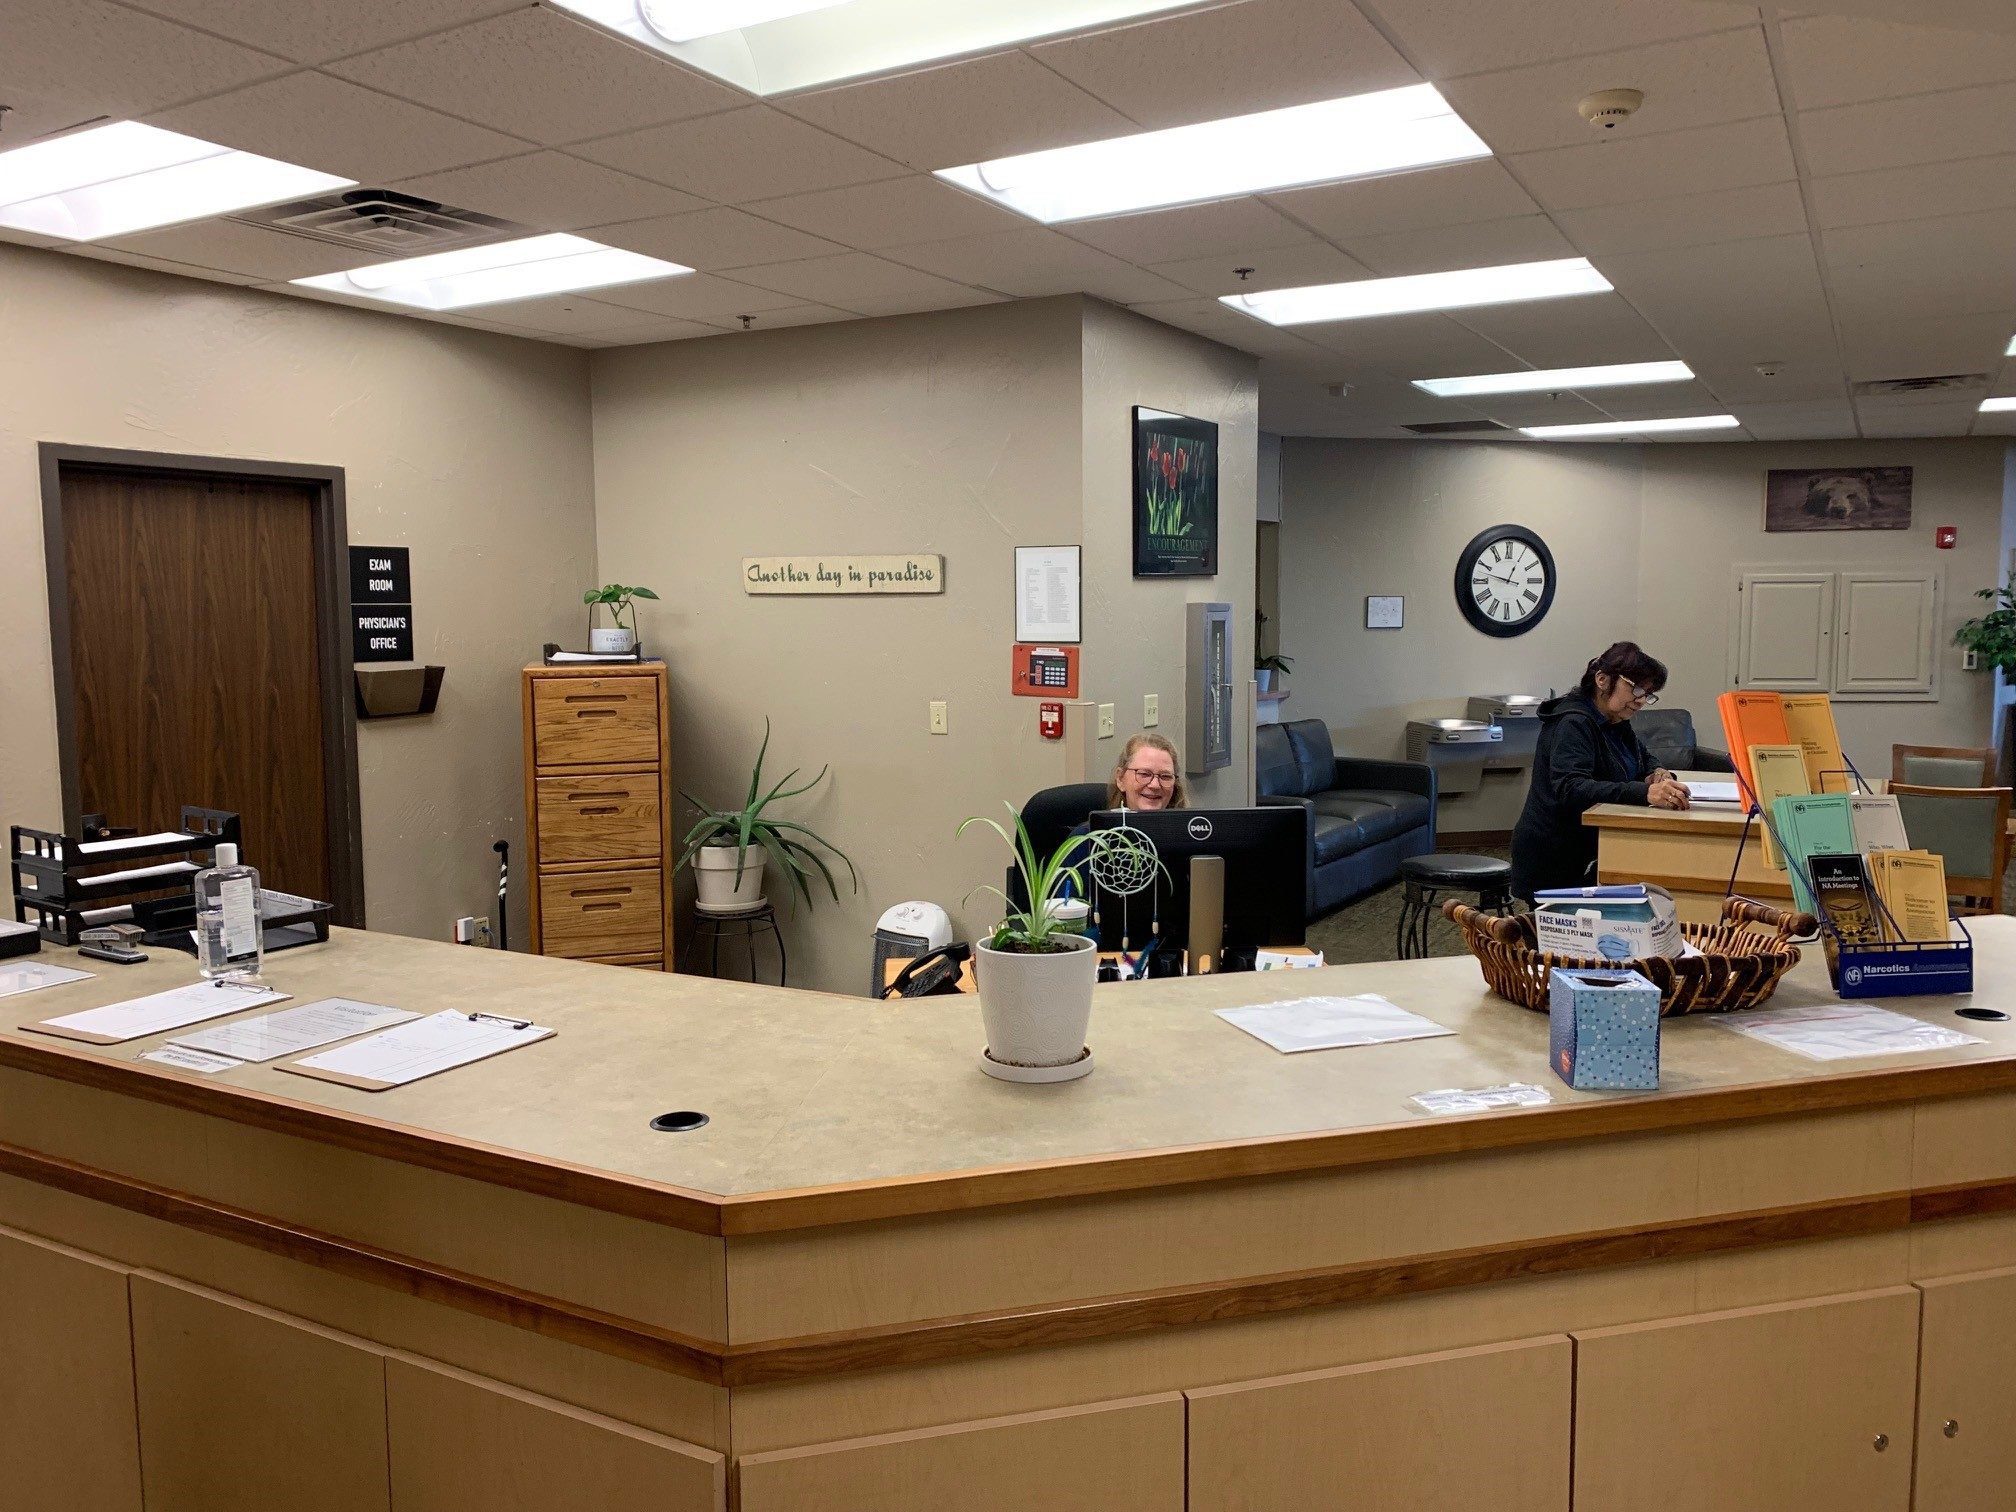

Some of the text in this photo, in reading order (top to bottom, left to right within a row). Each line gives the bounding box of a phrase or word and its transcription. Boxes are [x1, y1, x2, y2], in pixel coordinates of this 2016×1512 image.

[369, 559, 391, 571] EXAM
[747, 562, 934, 588] Another day in paradise
[369, 579, 393, 591] ROOM
[358, 617, 406, 629] PHYSICIAN'S
[370, 638, 398, 650] OFFICE
[1818, 874, 1852, 882] Introduction
[1833, 882, 1858, 890] Meetings
[1539, 916, 1578, 927] FACE MASKS
[1540, 926, 1566, 934] DISPOSABLE
[1864, 964, 1910, 974] Narcotics
